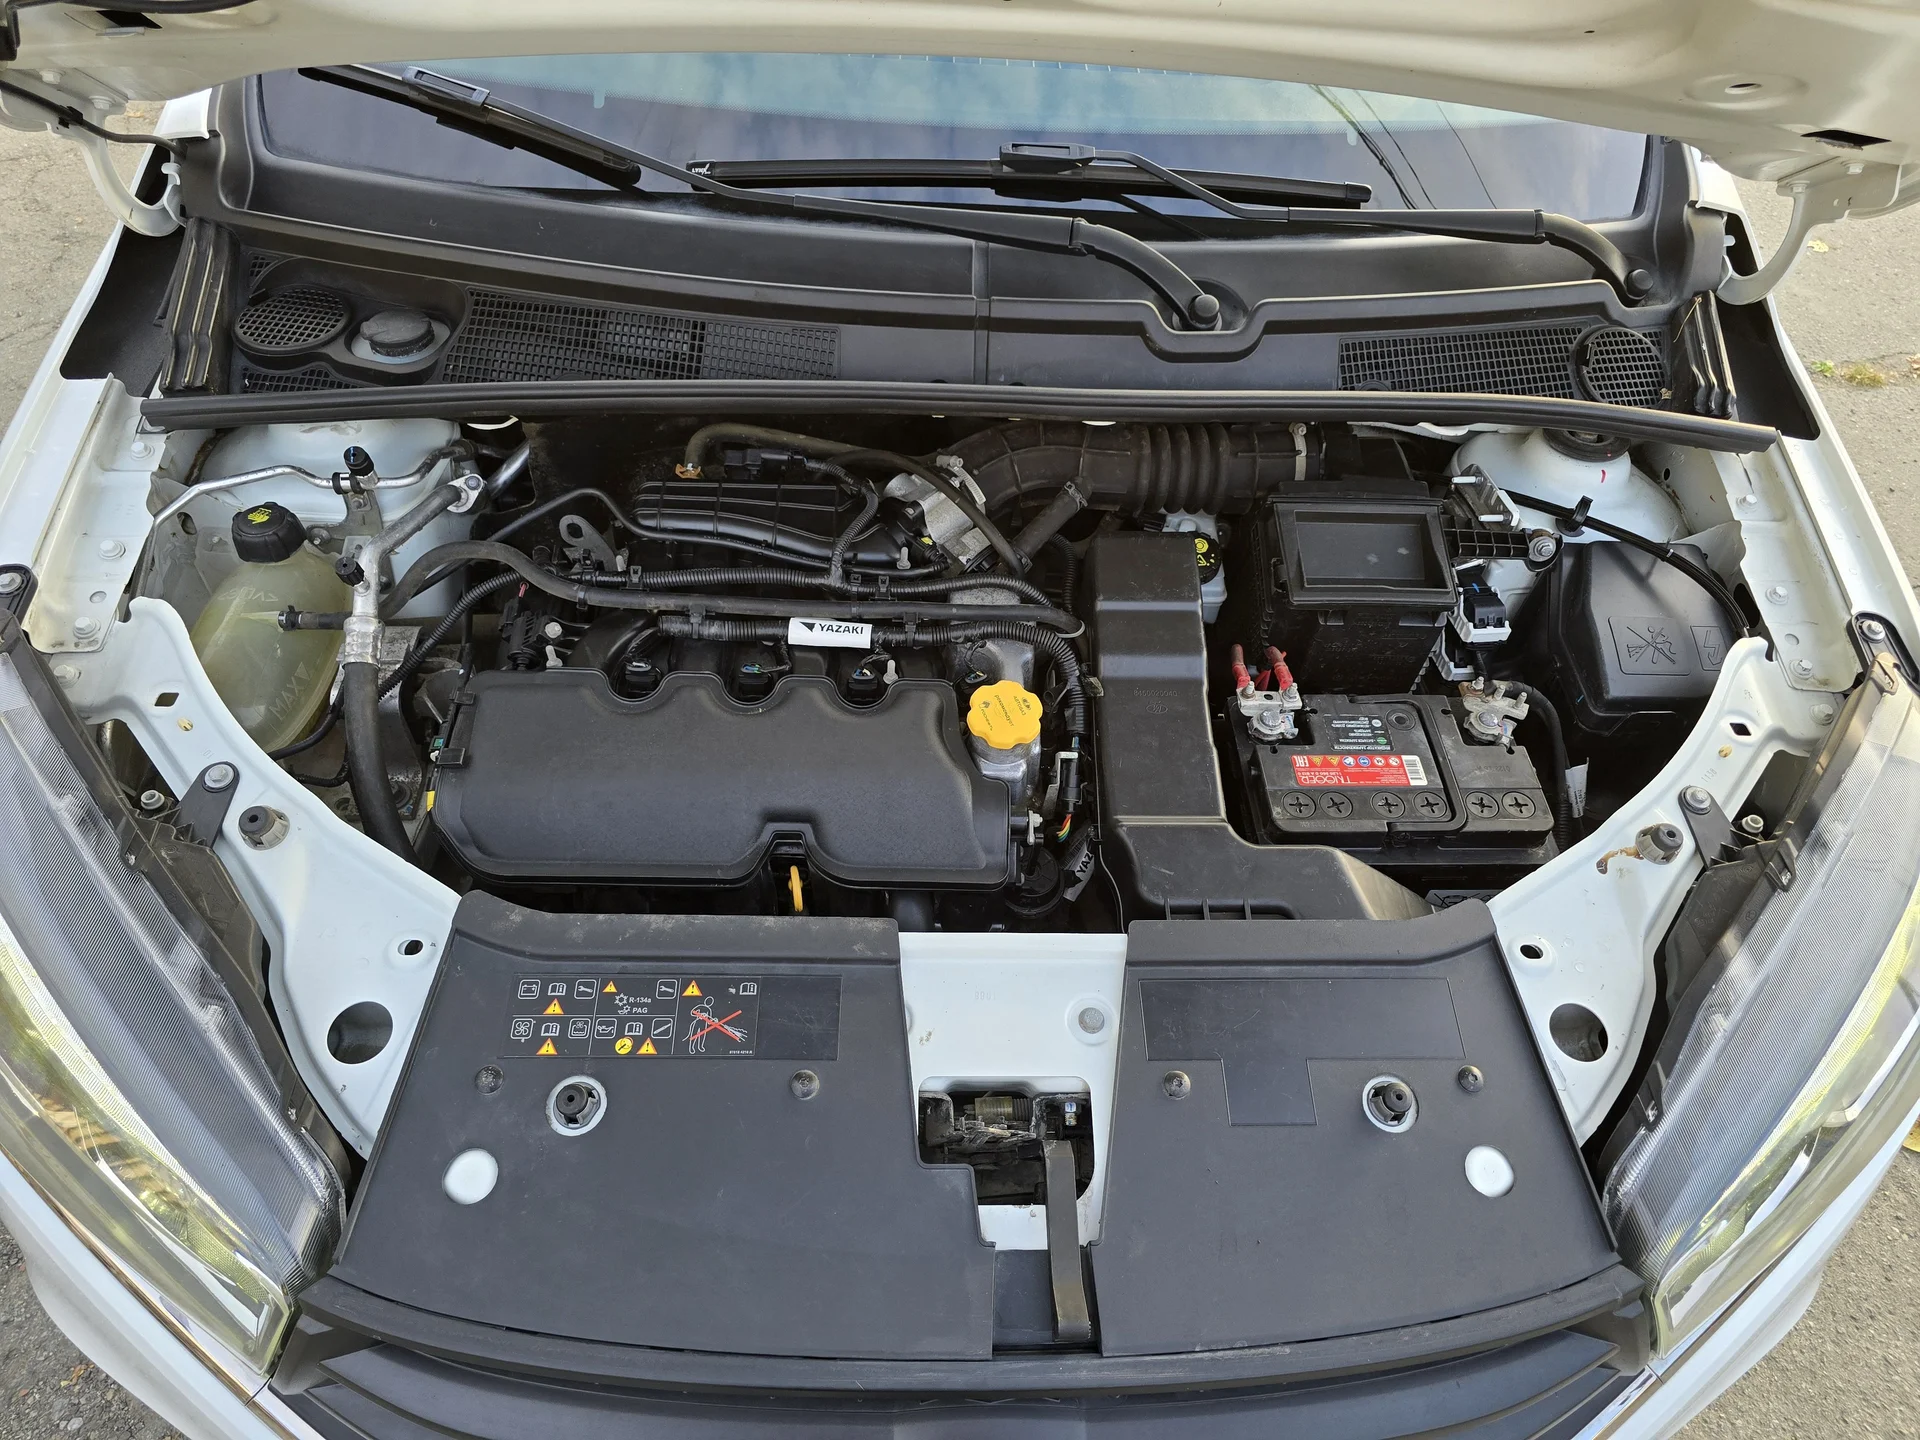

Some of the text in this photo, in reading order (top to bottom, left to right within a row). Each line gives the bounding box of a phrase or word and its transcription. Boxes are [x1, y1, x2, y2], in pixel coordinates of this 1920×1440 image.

[819, 623, 864, 635] YAZAKI
[268, 676, 304, 721] MAX
[994, 694, 1014, 727] рекомендует
